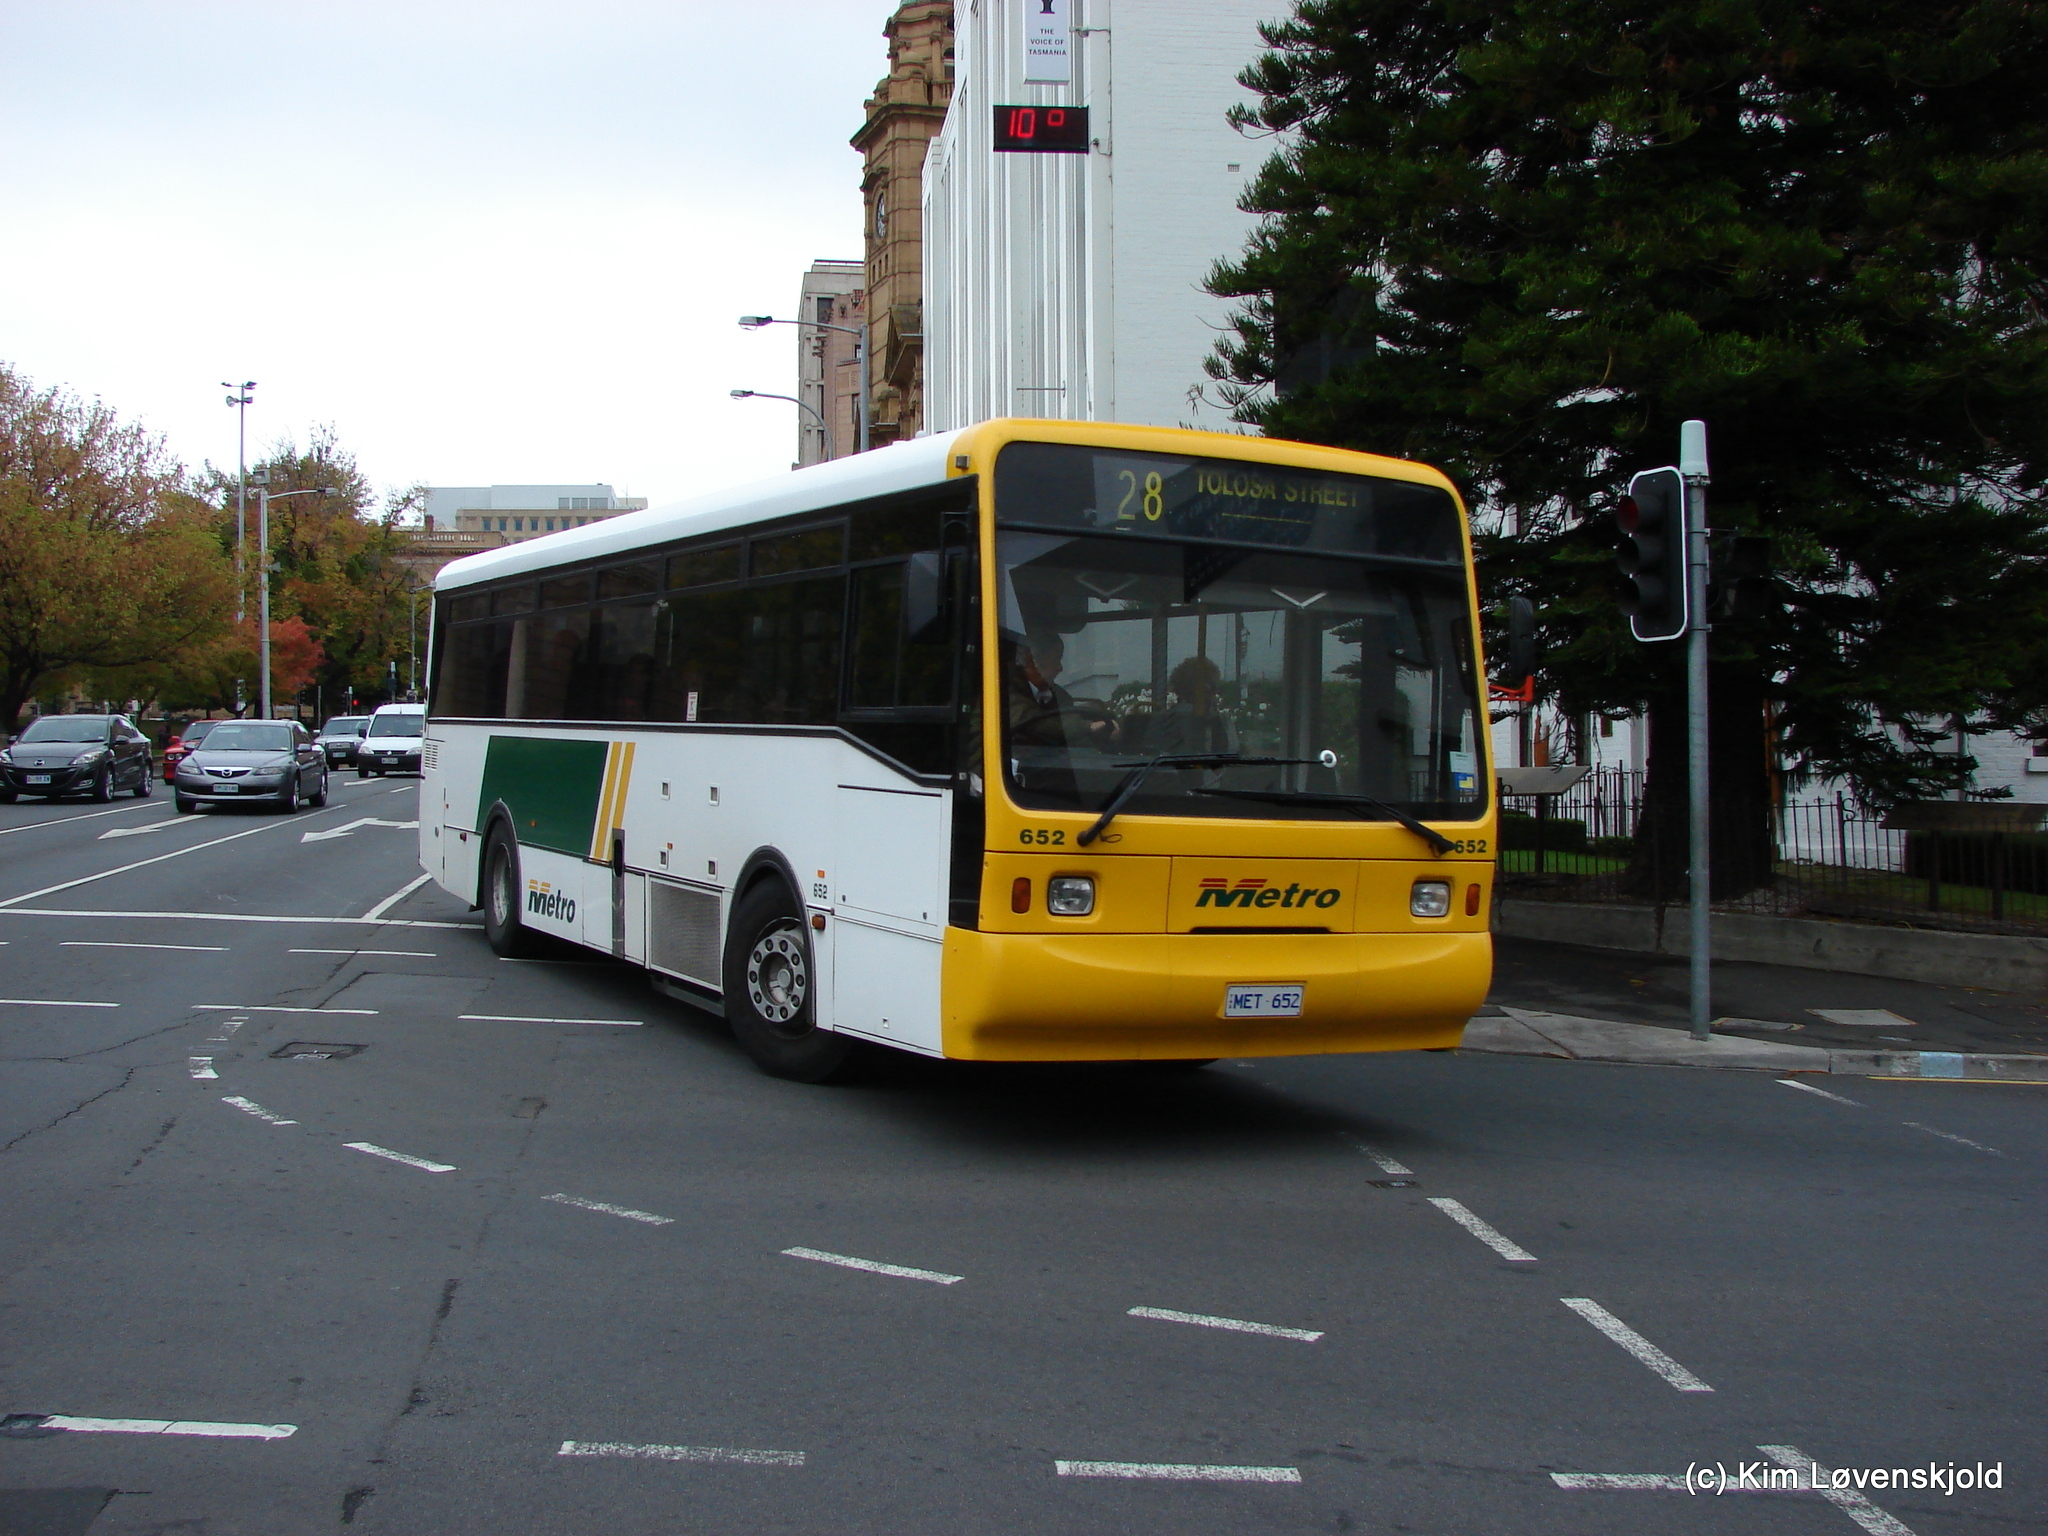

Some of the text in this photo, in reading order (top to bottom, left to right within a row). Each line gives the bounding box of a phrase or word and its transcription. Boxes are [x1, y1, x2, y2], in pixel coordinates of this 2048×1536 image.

[1030, 38, 1053, 46] VOICE
[1118, 468, 1359, 521] 28 TOLOSA STREET
[1019, 828, 1066, 846] 652
[1454, 839, 1488, 855] 652
[813, 882, 828, 900] 652
[1195, 878, 1342, 909] Metro
[528, 879, 577, 924] Metro
[1233, 993, 1264, 1009] MET
[1271, 993, 1300, 1009] 652
